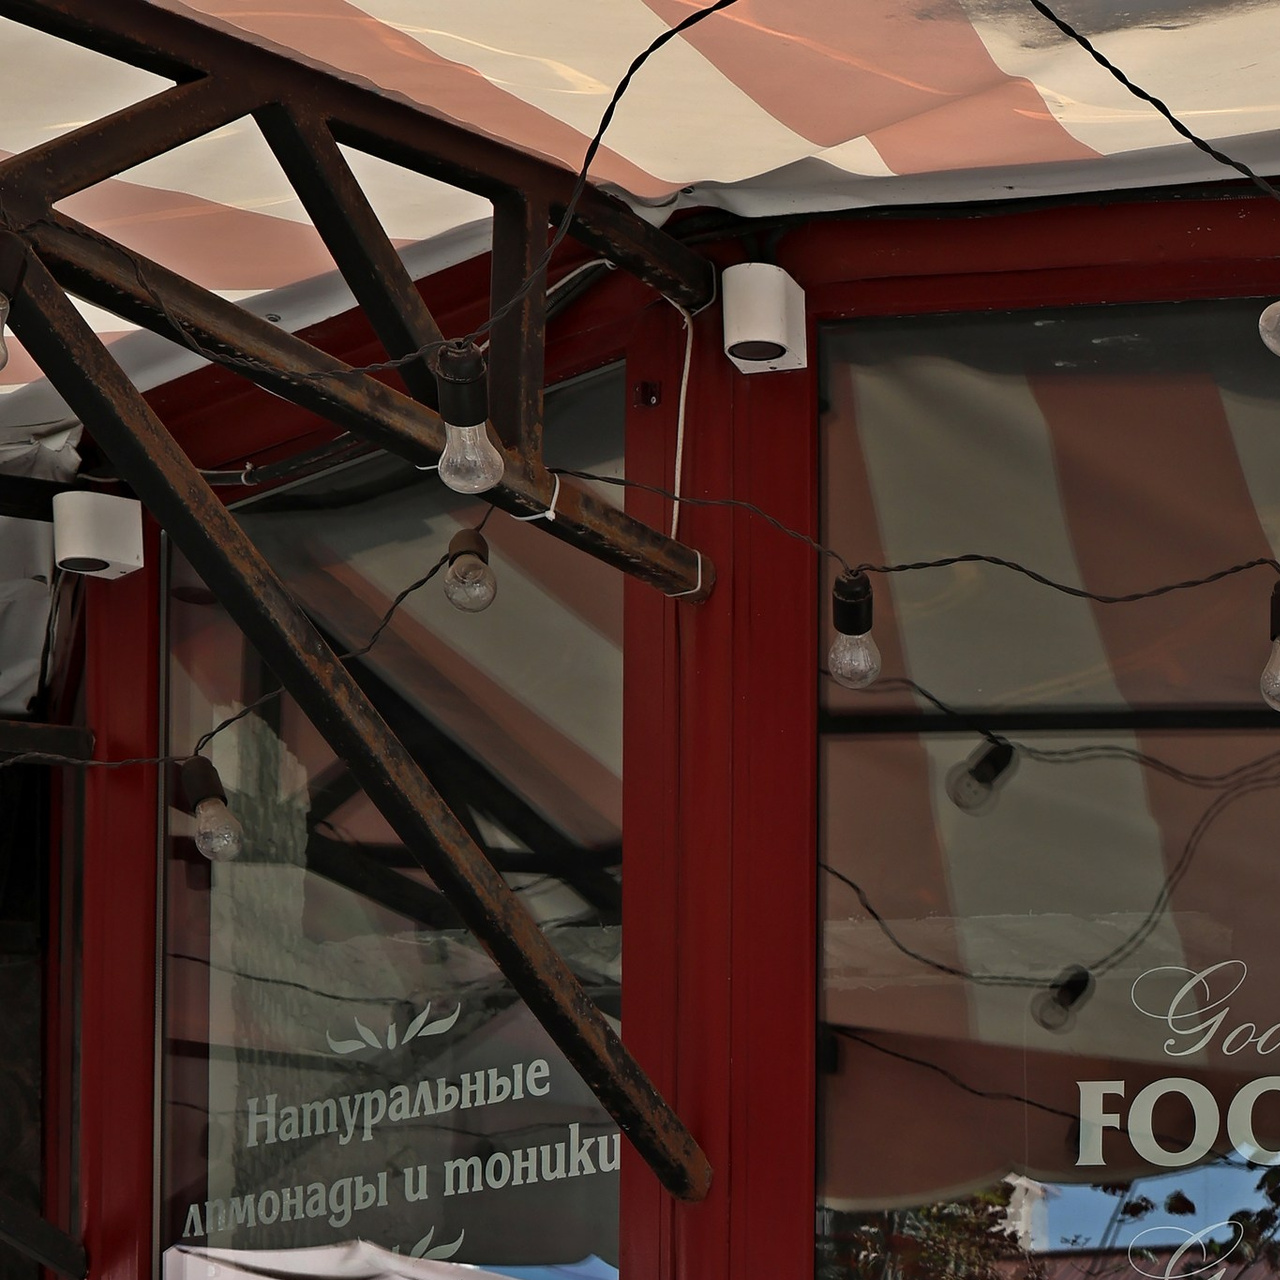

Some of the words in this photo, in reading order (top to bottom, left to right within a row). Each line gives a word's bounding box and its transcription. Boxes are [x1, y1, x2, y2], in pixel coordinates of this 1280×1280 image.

[246, 1058, 551, 1148] Натуральные
[403, 1164, 428, 1202] и
[443, 1122, 621, 1197] тоники
